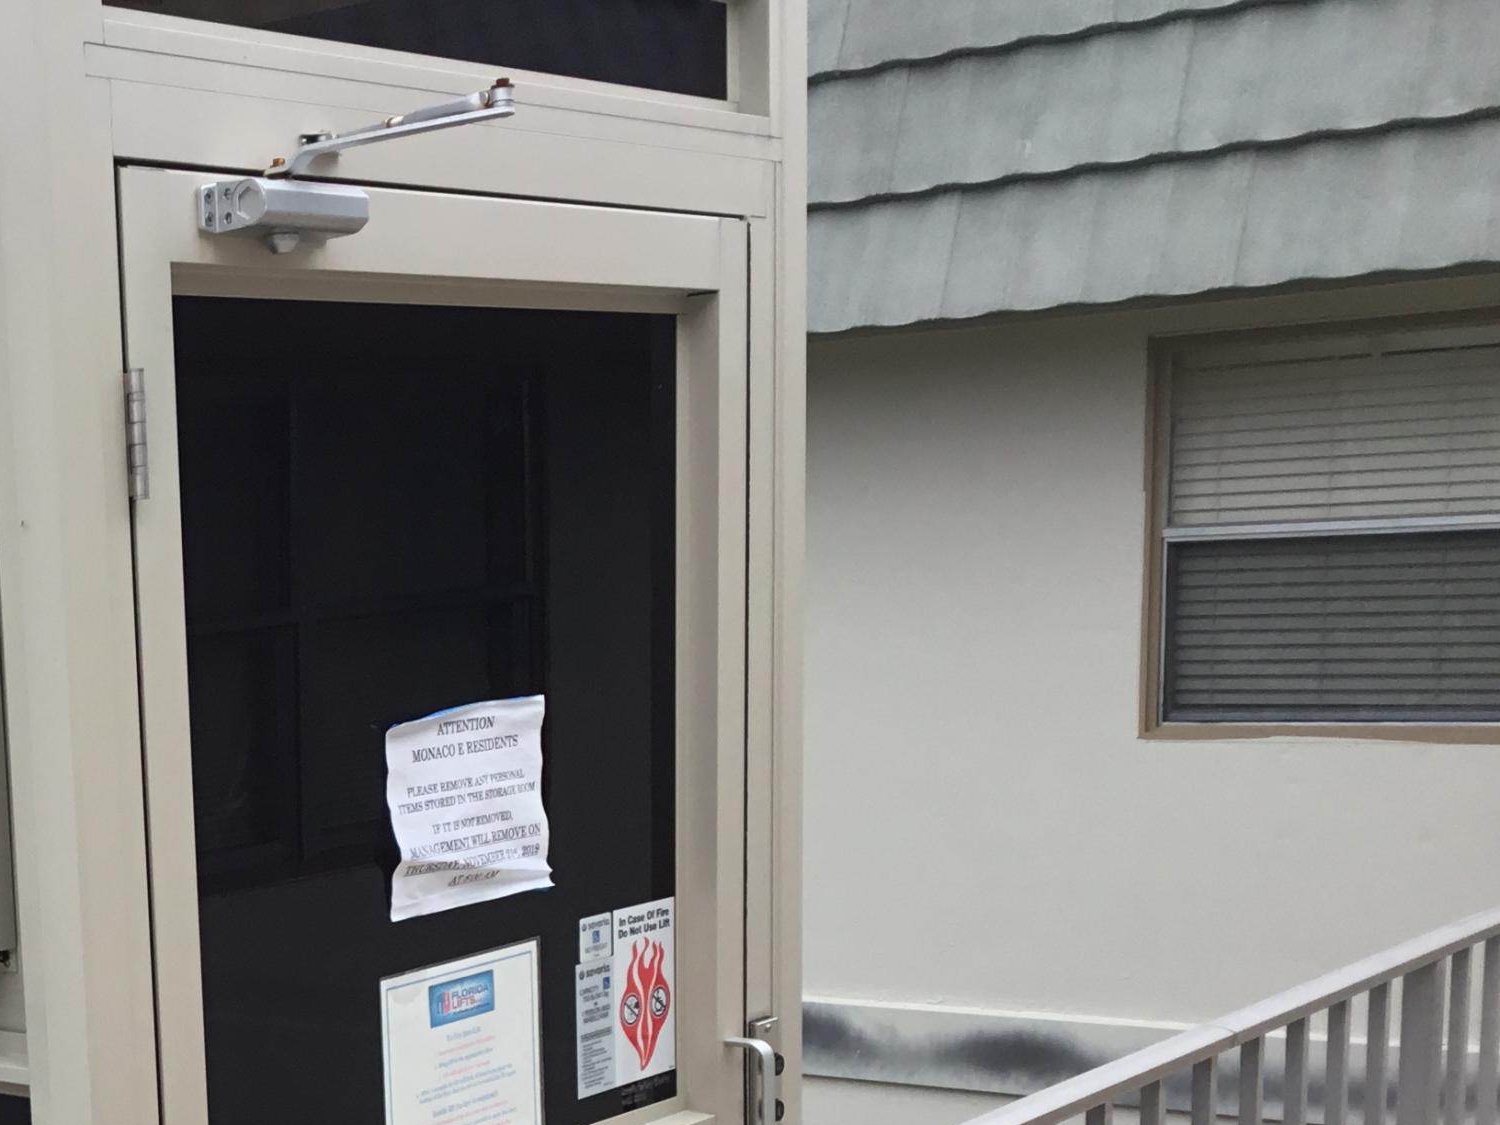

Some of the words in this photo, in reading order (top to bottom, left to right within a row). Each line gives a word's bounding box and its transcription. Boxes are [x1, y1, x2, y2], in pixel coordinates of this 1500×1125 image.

[437, 716, 495, 736] ATTENTION
[412, 744, 456, 763] MONACO
[458, 742, 465, 755] E
[466, 734, 519, 754] RESIDENTS
[406, 782, 439, 798] PLEASE
[440, 777, 473, 792] REMOVE
[474, 775, 489, 787] ANY
[490, 769, 525, 783] PERSONAL
[398, 802, 423, 815] ITEMS
[424, 796, 456, 811] STORED
[457, 794, 466, 805] IN
[467, 791, 484, 802] THE
[485, 785, 516, 800] STORAGE
[432, 824, 442, 835] IF
[442, 822, 452, 833] IT
[409, 836, 470, 859] MANAGEMENT
[470, 832, 492, 848] WILL
[492, 825, 527, 841] REMOVE
[528, 823, 541, 837] ON
[619, 917, 626, 927] In
[627, 914, 645, 925] Case
[647, 910, 655, 920] Of
[656, 908, 669, 918] Fire
[618, 929, 628, 939] Do
[629, 925, 642, 936] Not
[644, 922, 657, 933] Use
[659, 918, 670, 929] Lift
[451, 983, 489, 1000] FLORIDA
